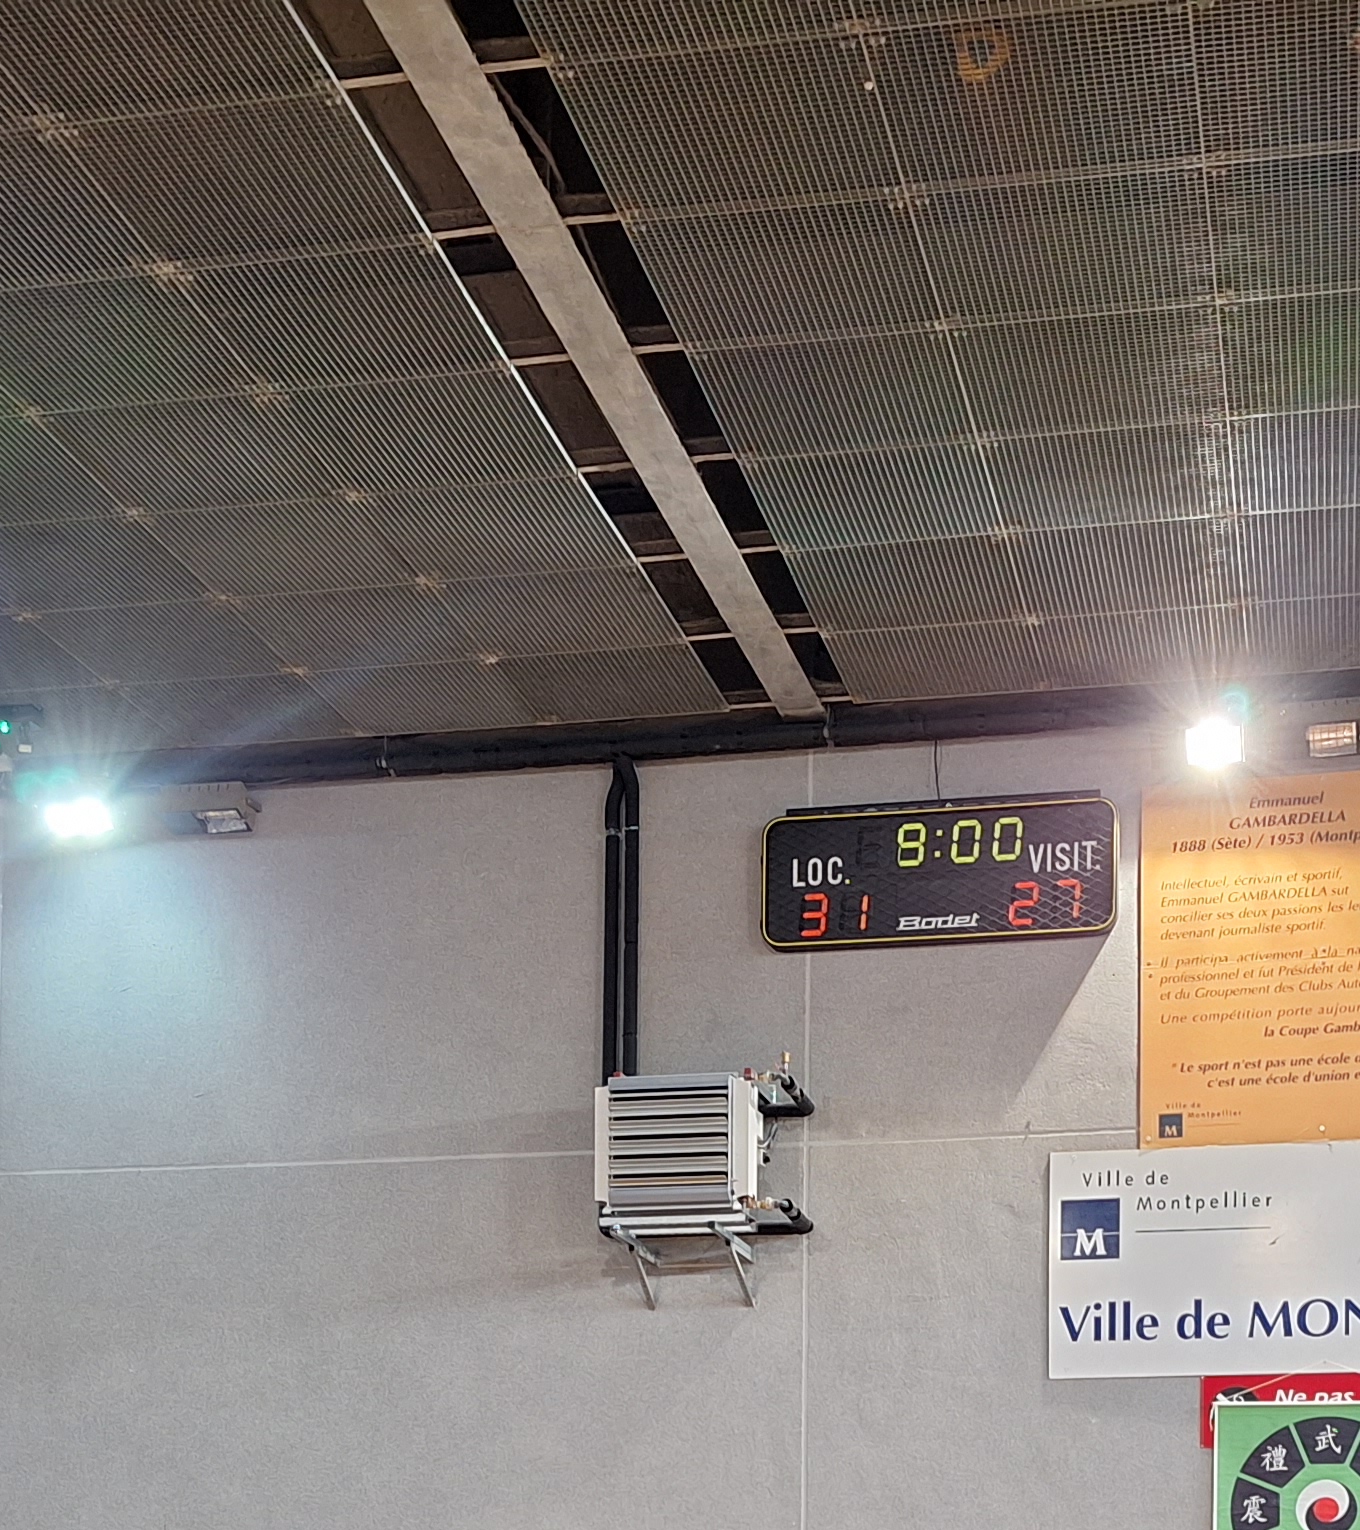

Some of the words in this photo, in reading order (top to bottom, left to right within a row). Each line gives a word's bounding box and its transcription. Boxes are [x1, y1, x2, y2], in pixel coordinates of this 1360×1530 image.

[1249, 791, 1324, 809] Emmanuel
[1229, 809, 1346, 830] GAMBARDELLA
[897, 817, 1024, 867] 8:00
[1172, 839, 1206, 854] 1888
[1211, 834, 1252, 853] (Sète)
[1270, 832, 1304, 846] 1953
[1028, 840, 1101, 873] VISIT.
[792, 856, 851, 888] LOC.
[1161, 876, 1230, 891] Intellectuel,
[1234, 873, 1282, 886] écrivain
[1286, 870, 1298, 882] et
[1008, 879, 1082, 926] 27
[1161, 892, 1224, 908] Emmanuel
[1228, 886, 1327, 903] GAMBARDELLA
[896, 913, 980, 931] Bodet
[1161, 909, 1213, 924] concilier
[1216, 911, 1235, 920] ses
[1238, 907, 1267, 920] deux
[1271, 903, 1323, 919] passions
[1327, 901, 1344, 913] les
[1160, 928, 1215, 941] devenant
[1218, 923, 1282, 940] journaliste
[1236, 949, 1303, 963] activement
[1160, 968, 1240, 987] professionnel
[1243, 967, 1254, 979] et
[1278, 962, 1334, 976] Président
[1337, 961, 1353, 973] de
[1160, 990, 1170, 1001] et
[1174, 988, 1190, 1000] du
[1194, 984, 1270, 999] Groupement
[1274, 981, 1295, 993] des
[1298, 979, 1333, 991] Clubs
[1160, 1013, 1187, 1025] Une
[1192, 1008, 1272, 1023] compétition
[1276, 1005, 1313, 1020] porte
[1264, 1026, 1275, 1037] la
[1279, 1025, 1319, 1038] Coupe
[1180, 1062, 1194, 1073] Le
[1197, 1060, 1229, 1075] sport
[1265, 1058, 1286, 1071] pas
[1290, 1057, 1313, 1067] une
[1317, 1052, 1350, 1065] école
[1239, 1076, 1262, 1086] une
[1266, 1071, 1299, 1085] école
[1082, 1170, 1134, 1187] Ville
[1145, 1170, 1169, 1186] de
[1136, 1191, 1272, 1213] Montpellier
[1074, 1228, 1107, 1256] M
[1059, 1301, 1159, 1342] Ville
[1176, 1299, 1230, 1340] de
[1315, 1424, 1341, 1454] 武
